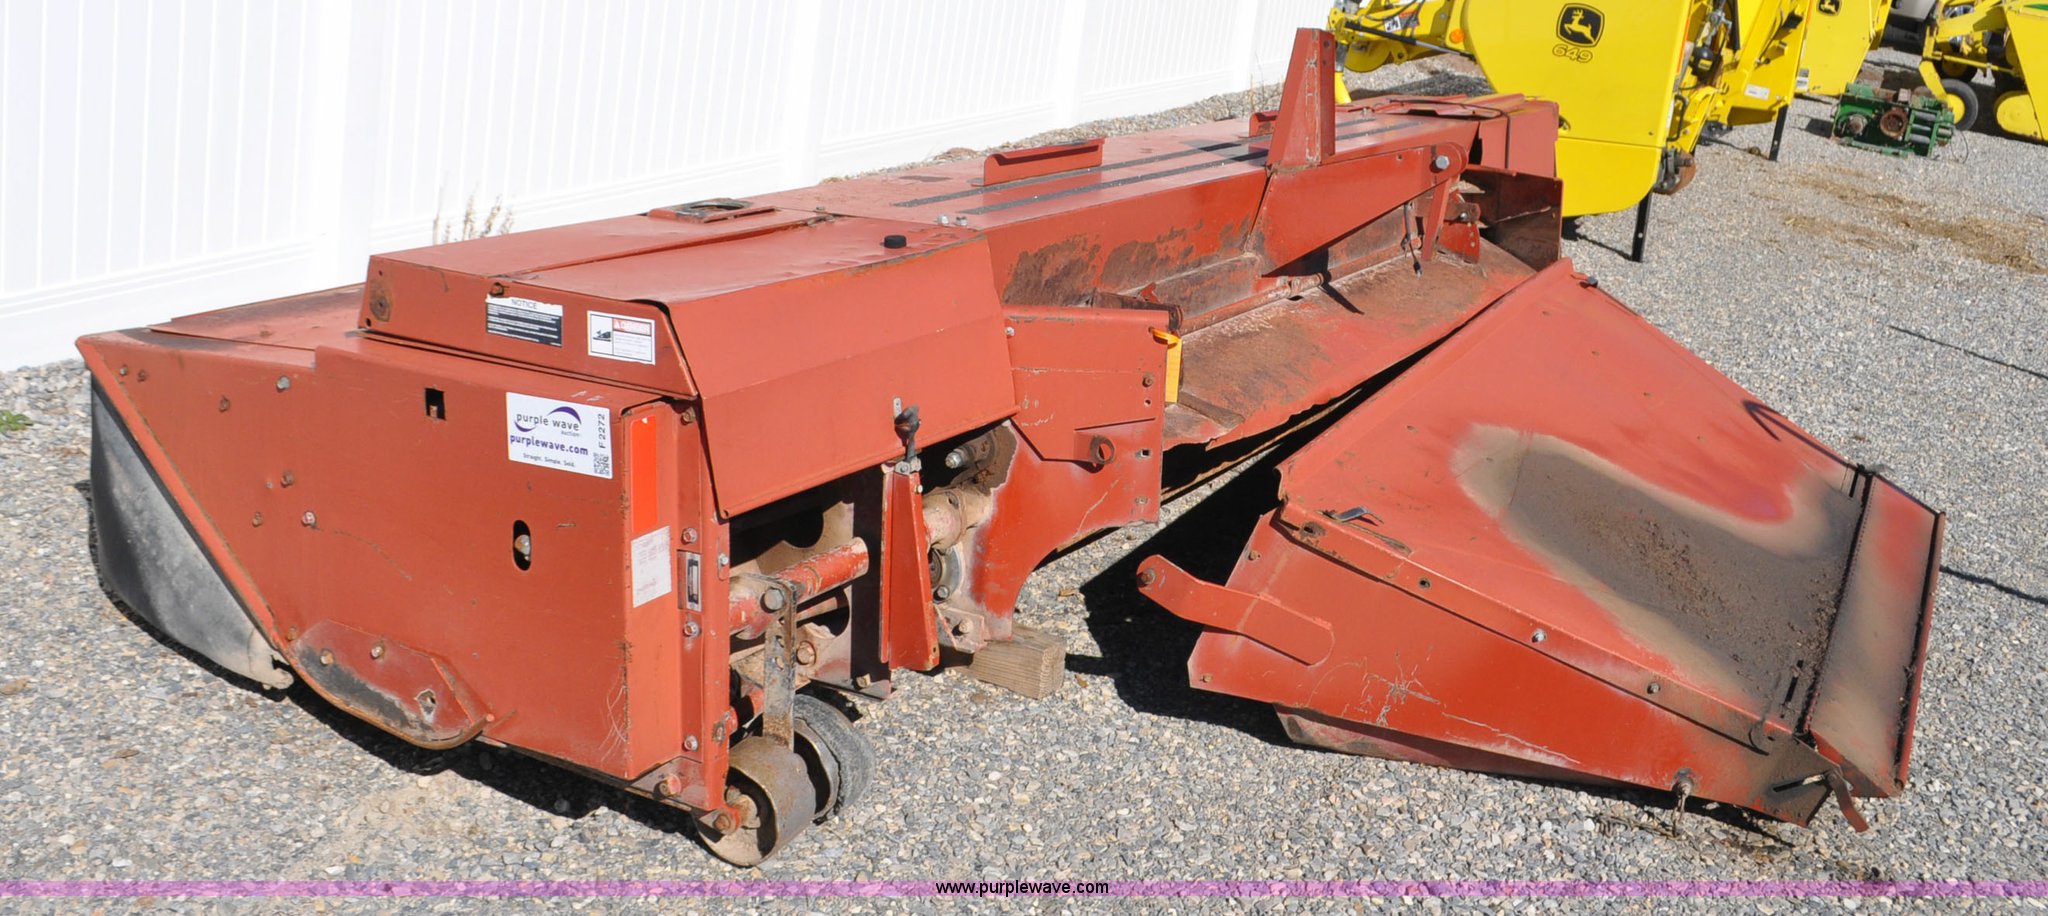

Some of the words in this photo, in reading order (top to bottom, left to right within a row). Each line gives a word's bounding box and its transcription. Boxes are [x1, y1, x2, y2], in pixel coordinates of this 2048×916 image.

[1552, 43, 1593, 63] 649
[511, 299, 537, 309] NOTICE
[516, 413, 549, 426] purple
[552, 420, 580, 431] wave
[598, 413, 606, 440] 2272
[510, 434, 589, 455] purplewave.com
